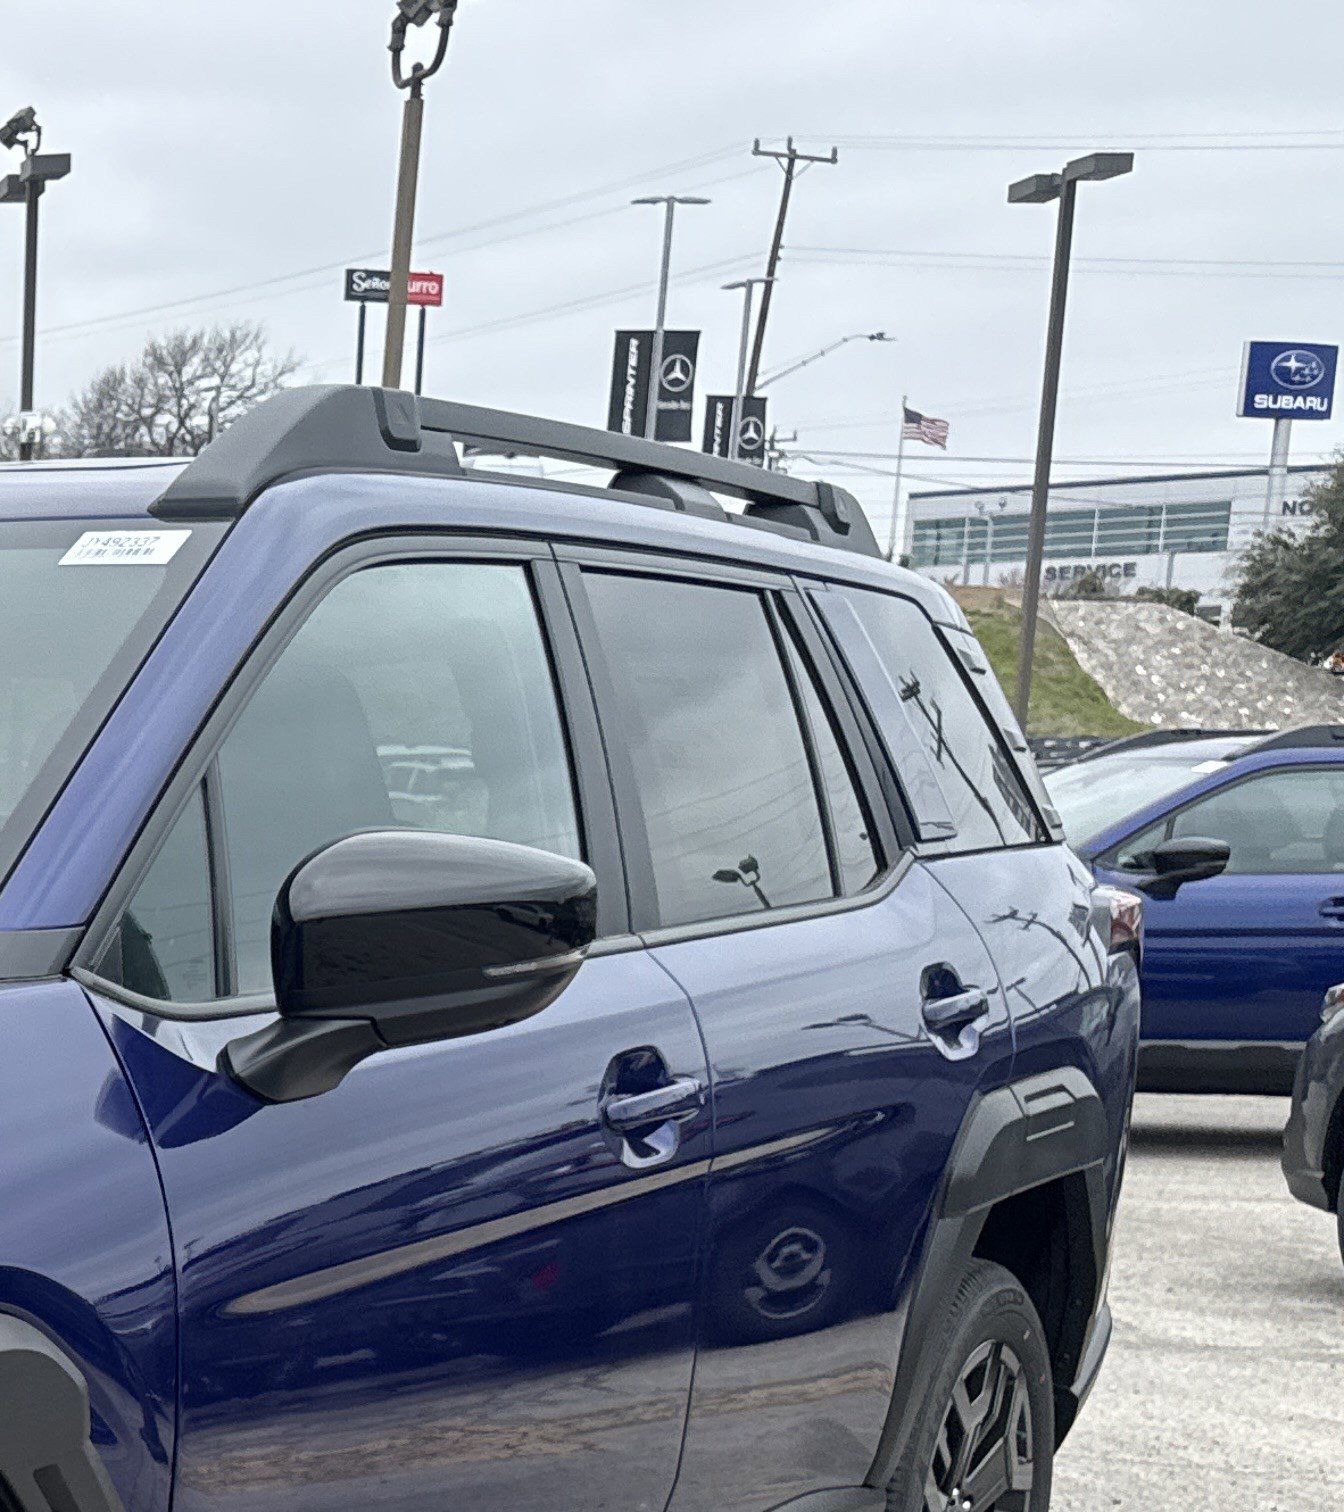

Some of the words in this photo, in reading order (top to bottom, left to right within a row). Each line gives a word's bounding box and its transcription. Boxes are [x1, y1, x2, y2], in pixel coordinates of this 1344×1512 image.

[408, 280, 440, 295] urro
[621, 338, 640, 434] SPRINTER
[1253, 393, 1328, 412] SUBARU
